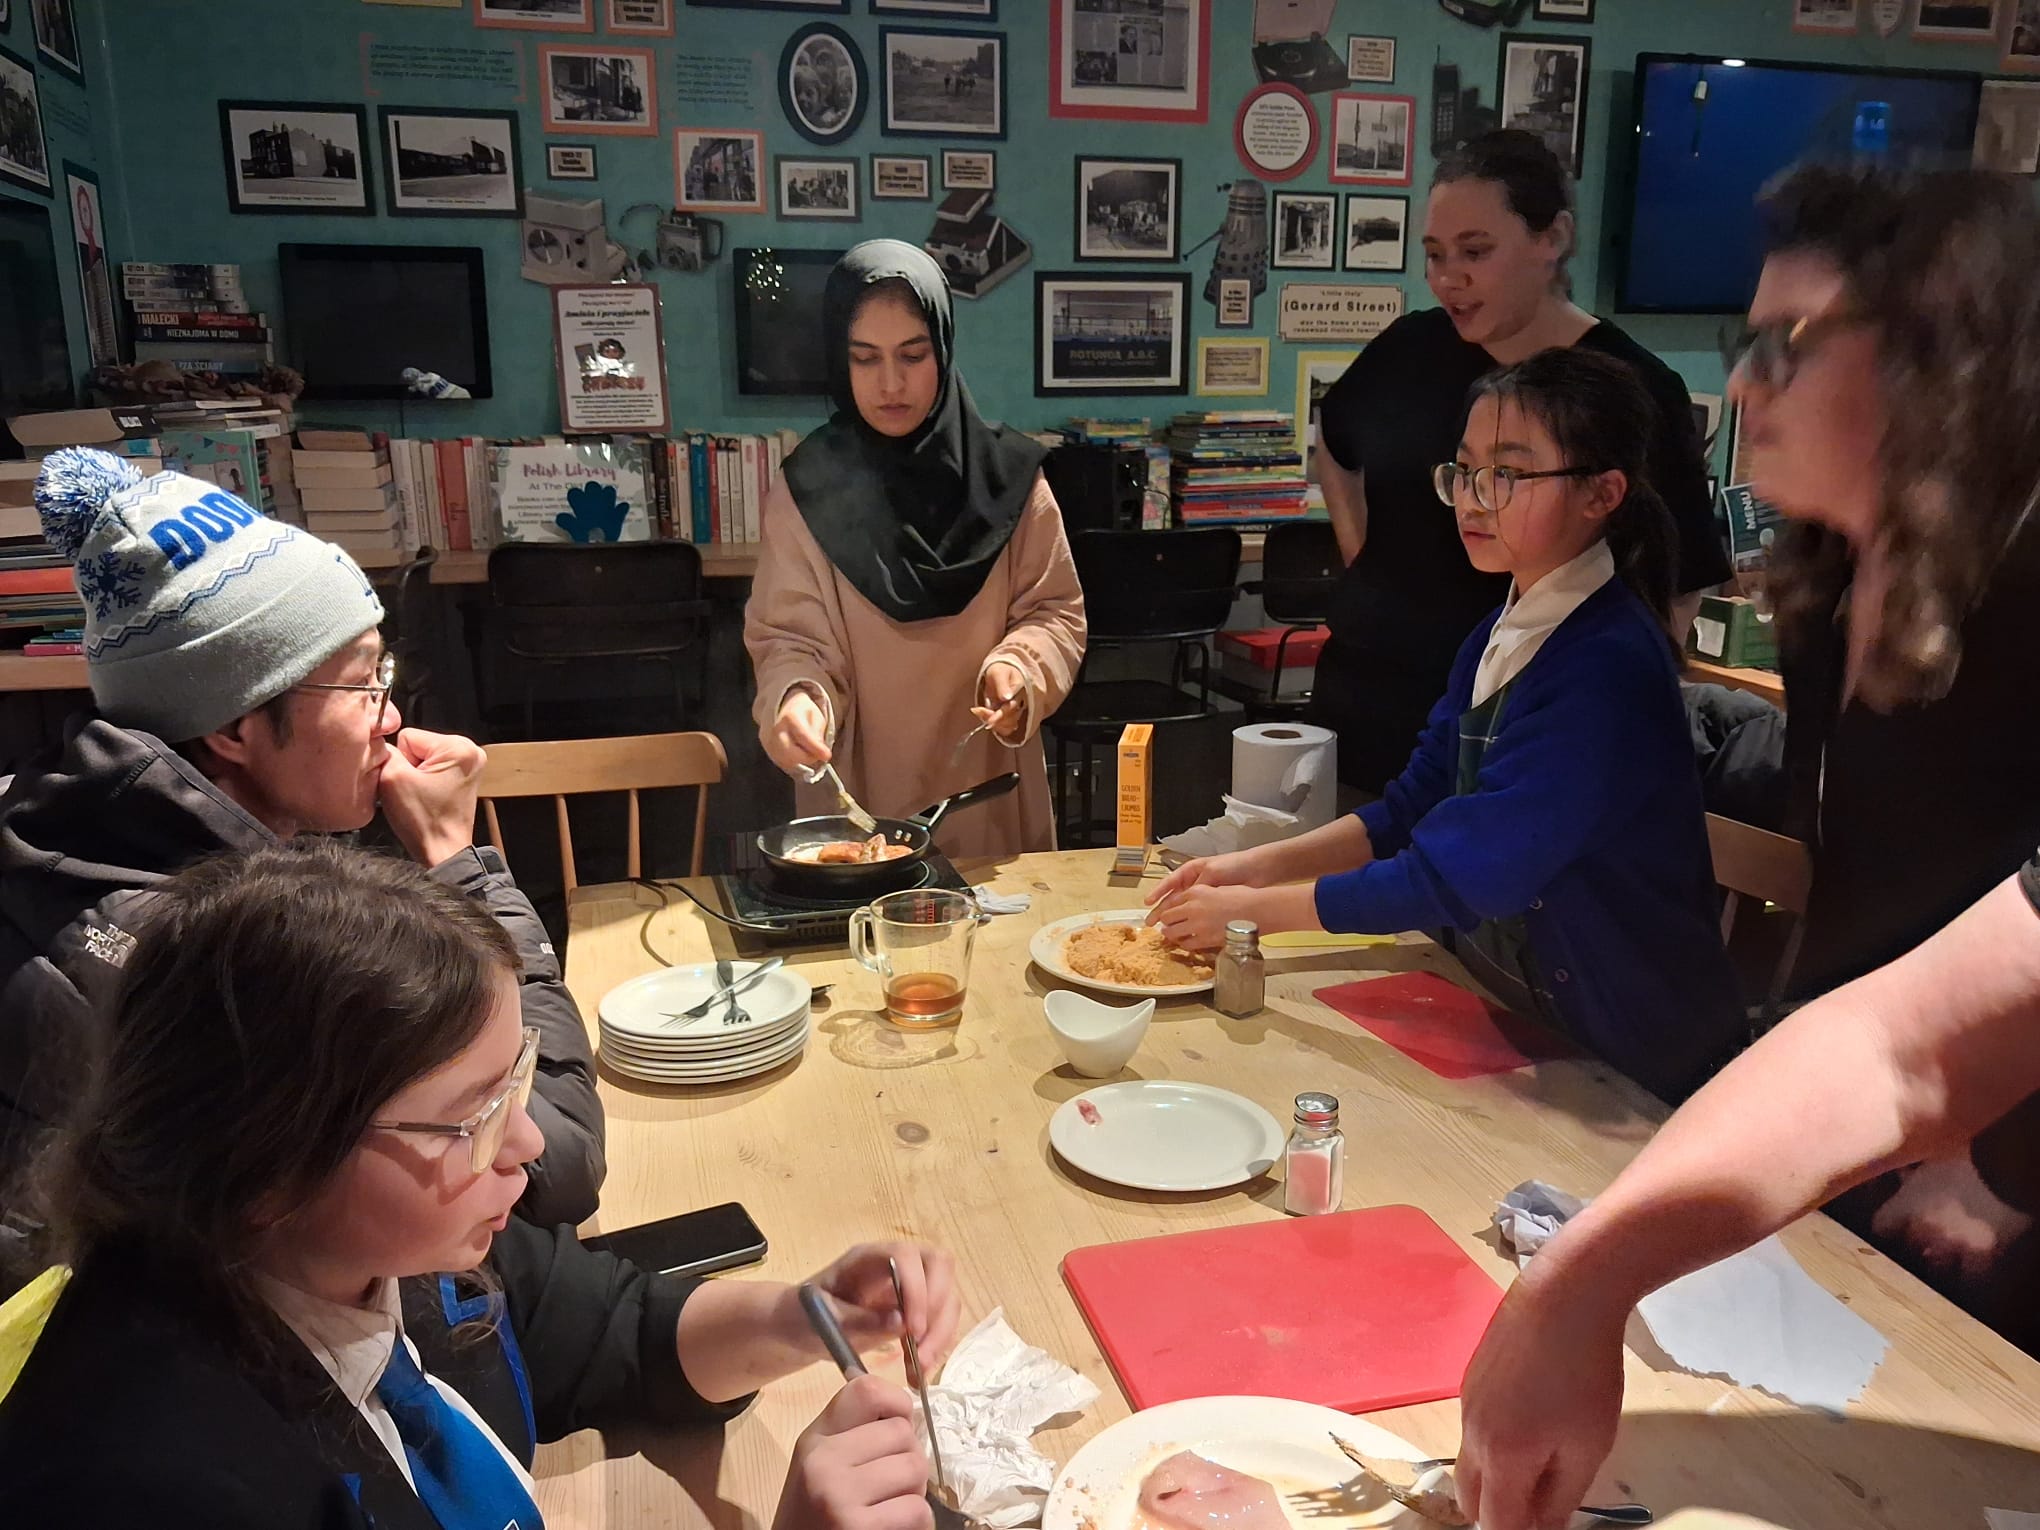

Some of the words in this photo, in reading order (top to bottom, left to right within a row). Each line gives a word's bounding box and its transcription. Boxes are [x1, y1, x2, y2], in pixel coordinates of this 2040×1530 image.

[1284, 300, 1340, 313] (Gerard
[1346, 301, 1397, 313] Street)
[1069, 349, 1123, 361] ROTUNDA
[523, 462, 558, 478] Polish
[565, 463, 616, 481] Library
[544, 482, 562, 491] The
[1740, 491, 1757, 530] MENU
